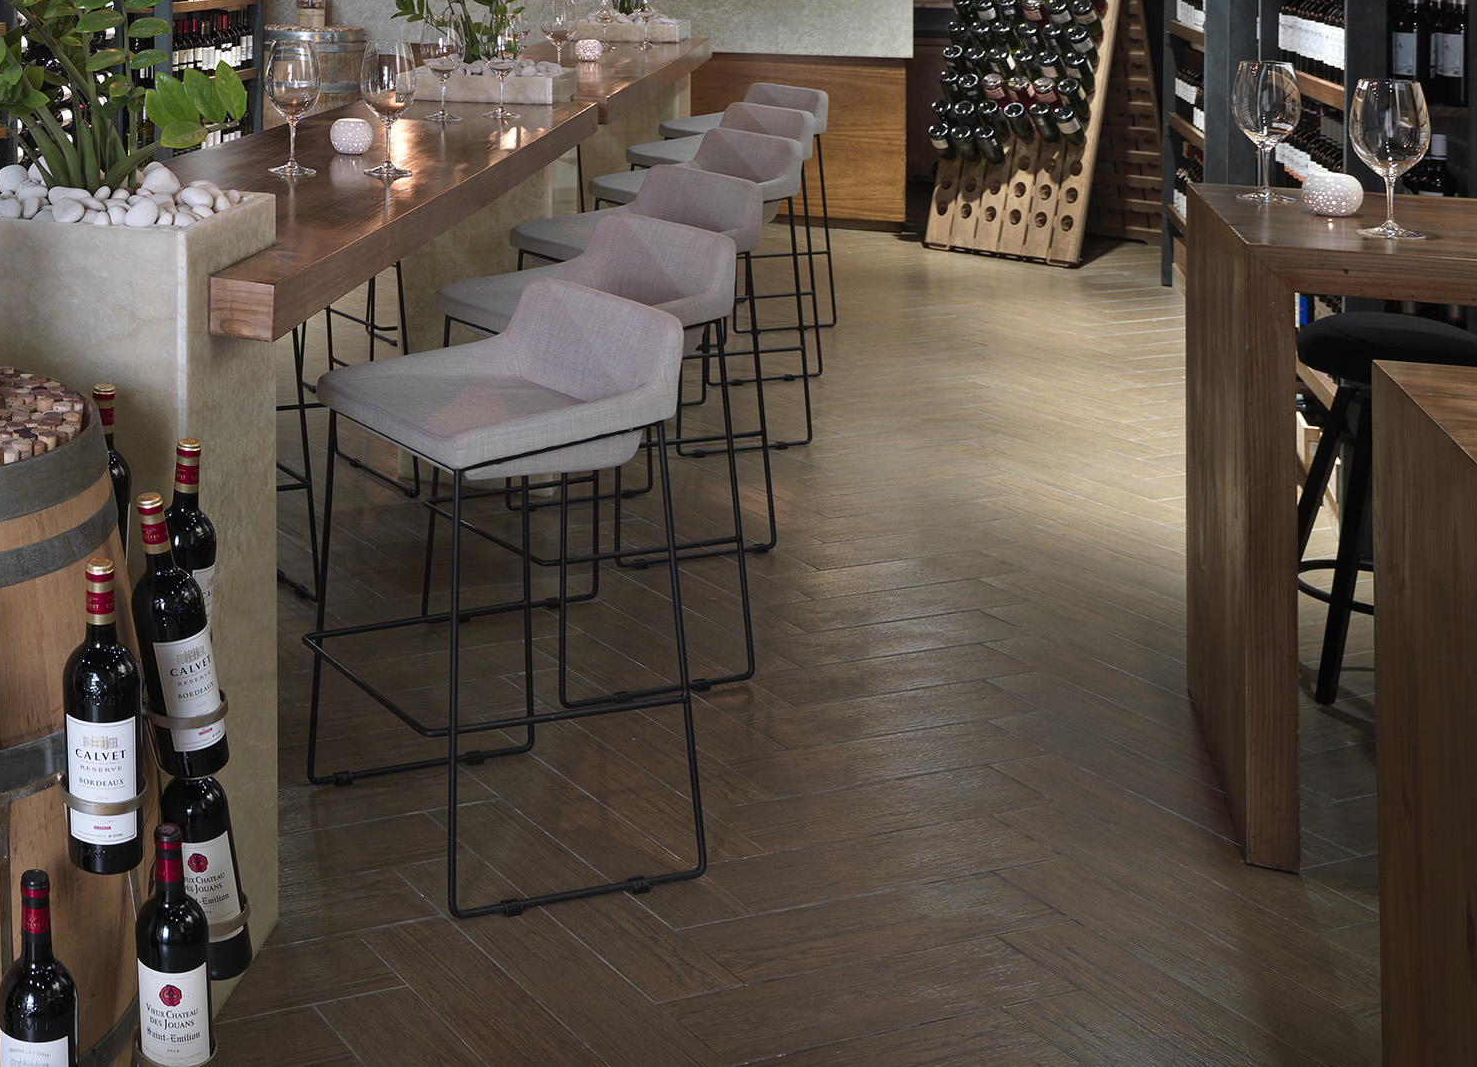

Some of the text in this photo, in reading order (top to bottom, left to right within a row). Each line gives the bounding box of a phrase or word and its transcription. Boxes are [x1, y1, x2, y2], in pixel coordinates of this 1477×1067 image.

[169, 653, 212, 678] CALVET
[177, 670, 212, 687] RESERVE
[177, 681, 215, 700] BORDEAUX
[75, 748, 127, 761] CALVET
[80, 764, 123, 772] RESERVE
[79, 777, 124, 787] BORDEAUX
[195, 872, 225, 884] CHATEAU
[195, 882, 223, 894] JOUANS
[166, 1008, 199, 1019] CHATEAU
[149, 1017, 195, 1030] DES JOUANS
[146, 1026, 201, 1043] Saint-Emilion
